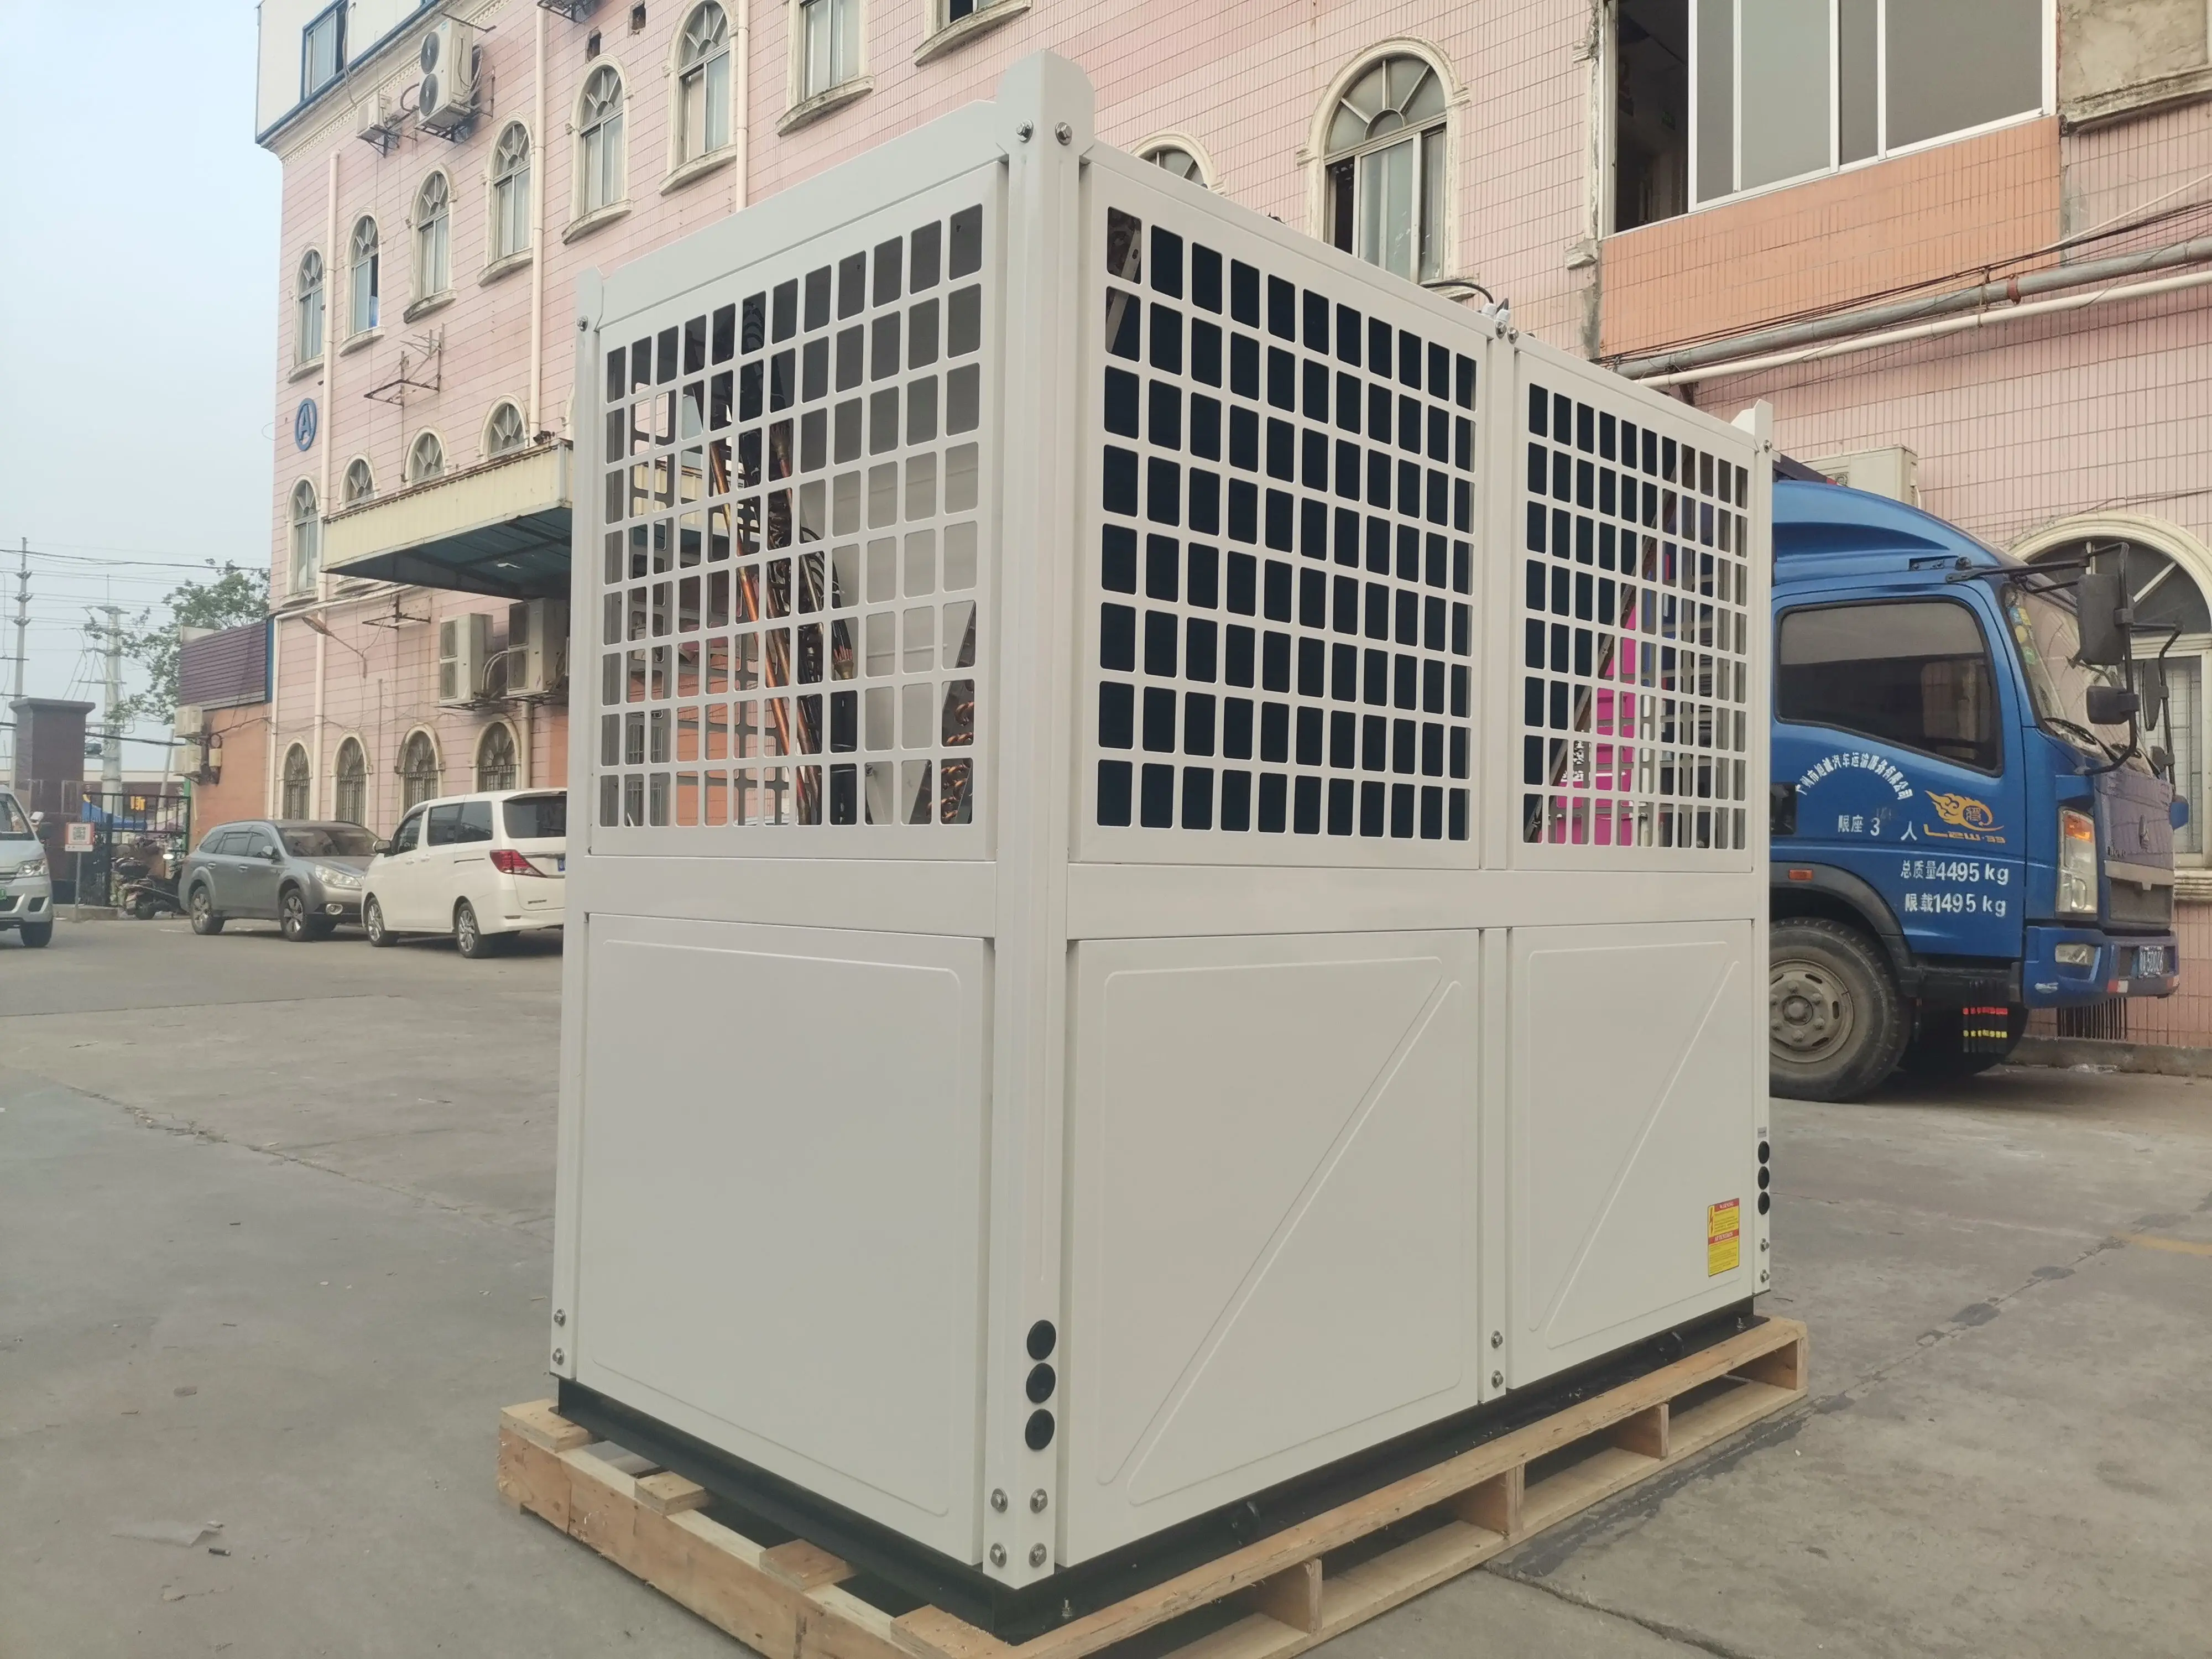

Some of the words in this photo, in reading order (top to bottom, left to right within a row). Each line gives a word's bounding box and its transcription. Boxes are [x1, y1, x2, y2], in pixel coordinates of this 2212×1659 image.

[1838, 815, 1864, 832] 限座
[1870, 817, 1880, 836] 3
[1900, 821, 1918, 841] 人
[1985, 863, 2008, 885] kg
[1983, 895, 2006, 917] kg
